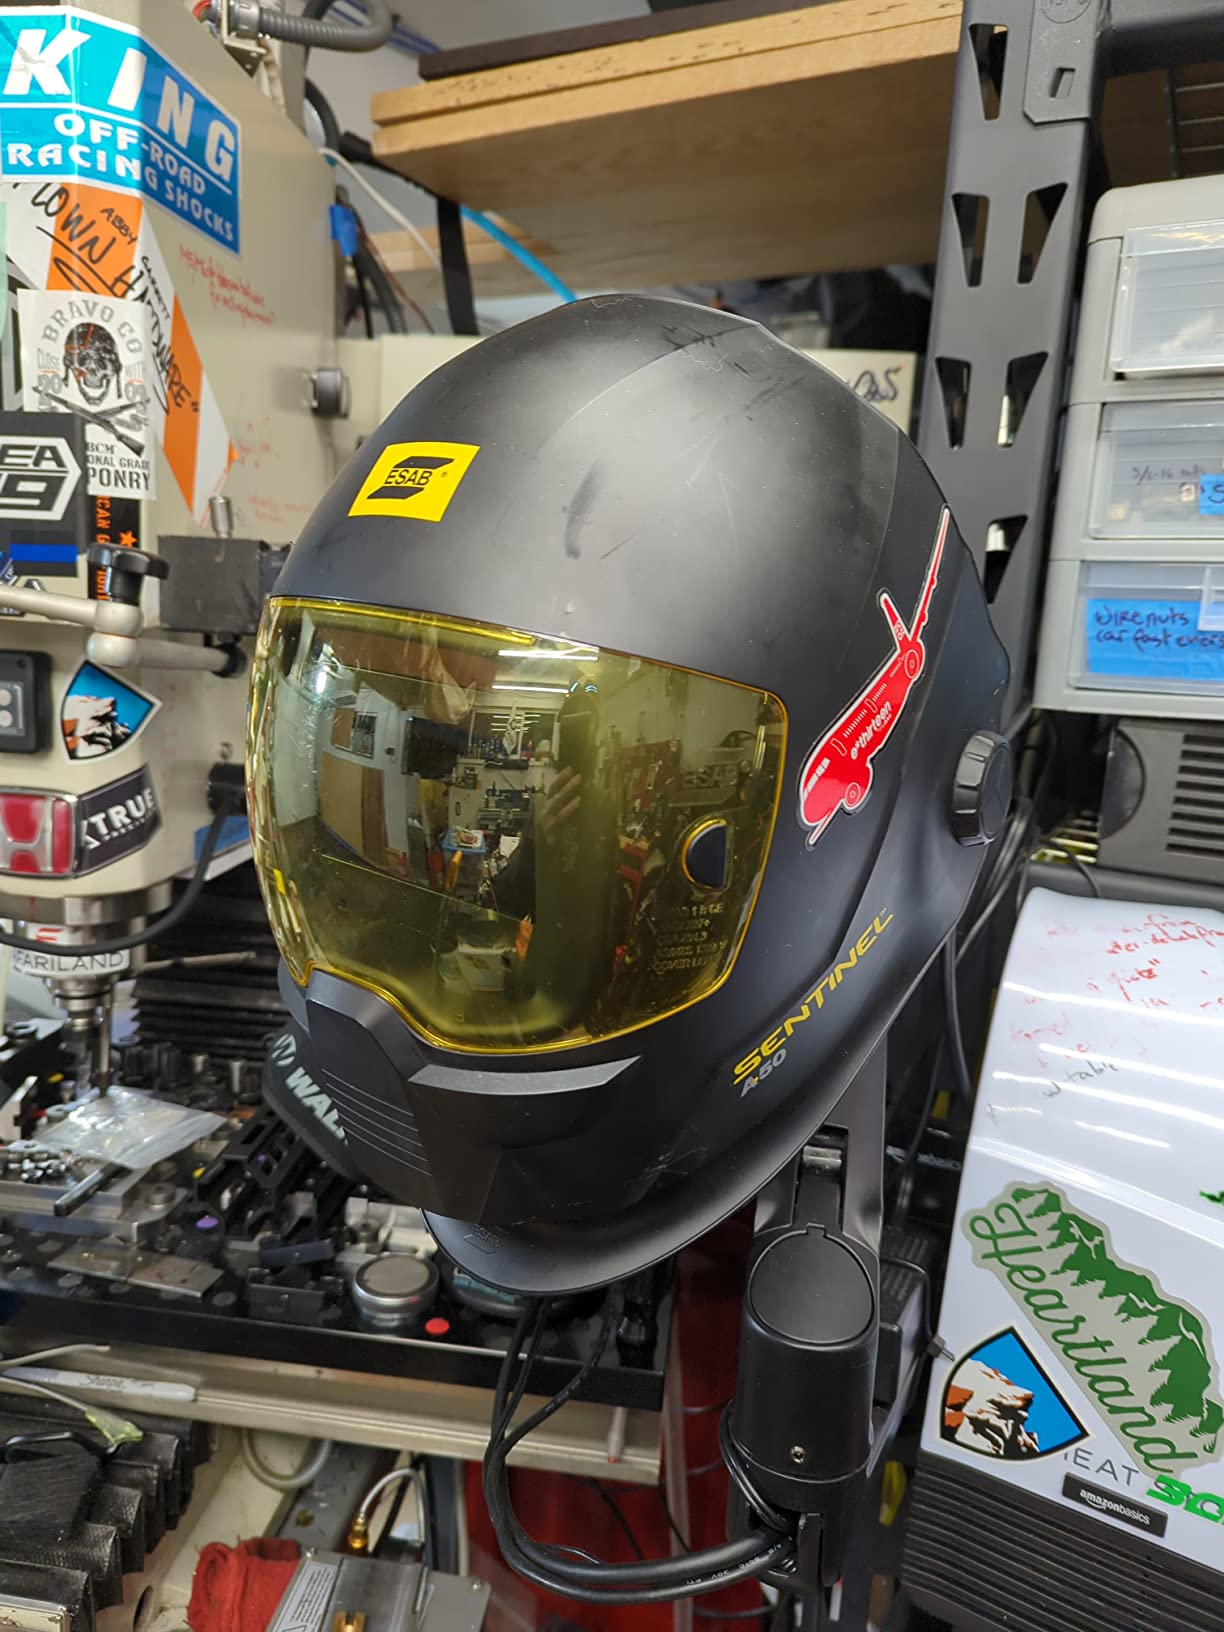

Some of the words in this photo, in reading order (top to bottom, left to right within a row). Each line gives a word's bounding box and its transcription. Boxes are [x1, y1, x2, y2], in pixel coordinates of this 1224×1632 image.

[3, 28, 235, 182] KING
[7, 143, 158, 191] RACING
[165, 184, 234, 243] SHOCKS
[54, 113, 206, 196] OFF-ROAD
[13, 183, 117, 264] LOWN
[41, 299, 115, 343] BRAVO
[118, 321, 143, 353] CO
[87, 454, 116, 468] ONAL
[87, 466, 150, 491] PONRY
[384, 469, 433, 487] ESAB
[733, 912, 895, 1086] SENTINEL
[970, 1201, 1199, 1474] Heartland
[1080, 1488, 1151, 1526] amazonbasics
